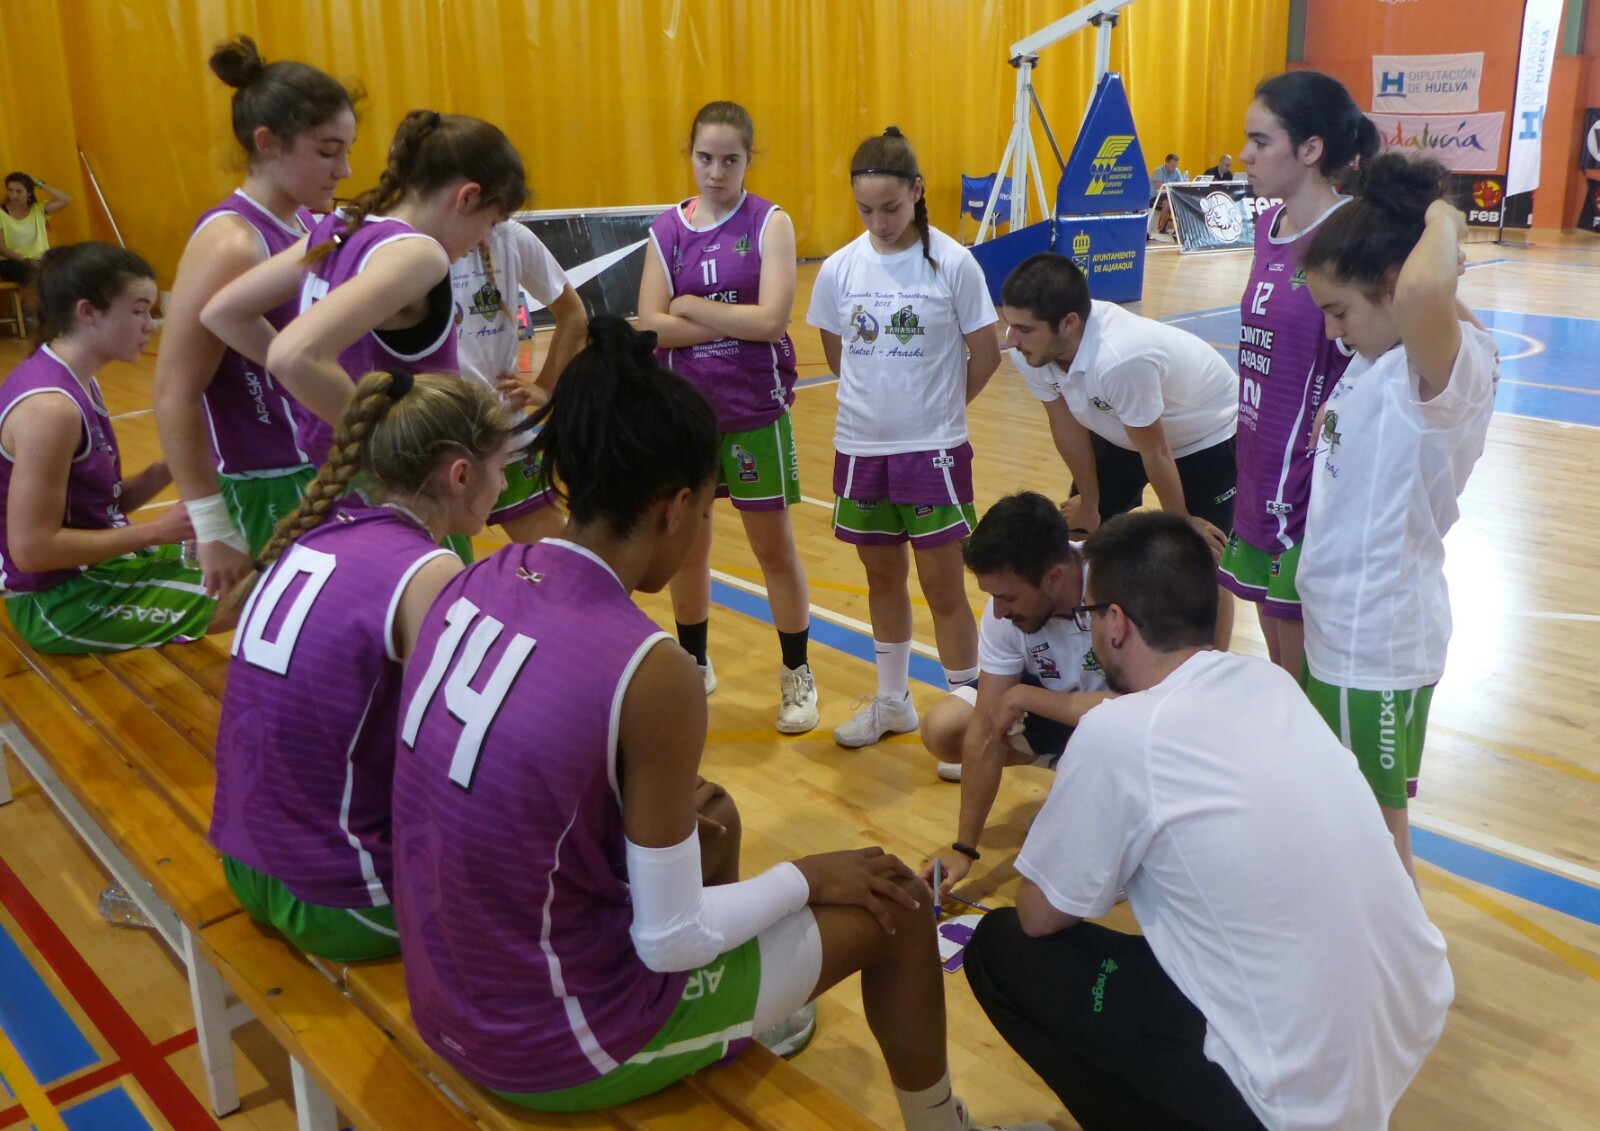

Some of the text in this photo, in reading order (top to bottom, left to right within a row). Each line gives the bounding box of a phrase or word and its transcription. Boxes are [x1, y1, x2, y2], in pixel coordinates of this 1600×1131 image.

[1535, 29, 1550, 83] HUELVA
[1407, 82, 1468, 93] DE HUELVA
[1408, 68, 1476, 81] DIPUTACIÓN
[1379, 120, 1486, 151] ndalucía
[1092, 250, 1136, 262] AYUNTAMIENTO
[1094, 261, 1134, 273] DE ALJARAQUE
[701, 258, 718, 286] 11
[1251, 281, 1274, 316] 12
[886, 346, 925, 357] Araski
[231, 543, 337, 677] 10
[401, 596, 538, 790] 14
